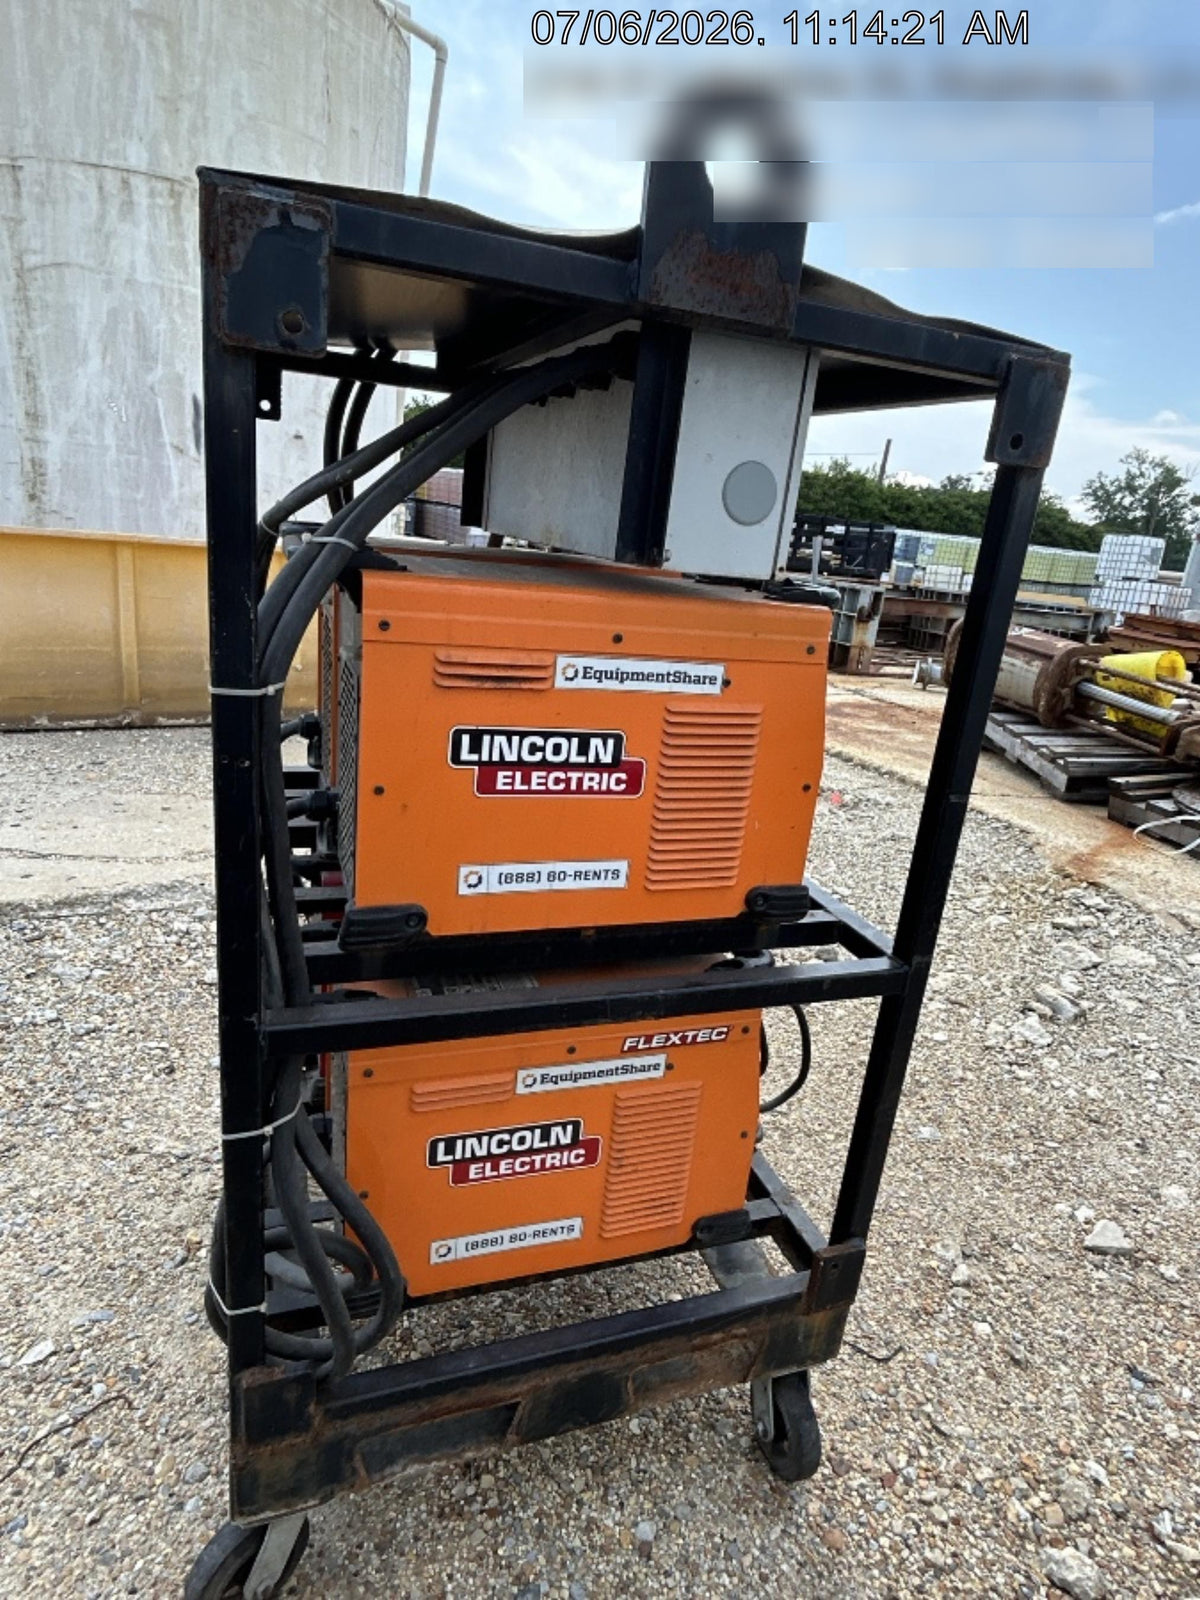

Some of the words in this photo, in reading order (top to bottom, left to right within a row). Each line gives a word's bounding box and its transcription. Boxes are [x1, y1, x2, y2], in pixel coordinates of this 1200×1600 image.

[581, 667, 719, 688] EquipmentShare
[459, 734, 614, 763] LINCOLN
[495, 772, 628, 792] ELECTRIC
[497, 870, 541, 885] (888)
[623, 1026, 728, 1051] FLEXTEC
[539, 1060, 661, 1086] EquipmentShare
[436, 1125, 575, 1163] LINCOLN
[468, 1148, 586, 1180] ELECTRIC
[465, 1235, 504, 1252] (888)
